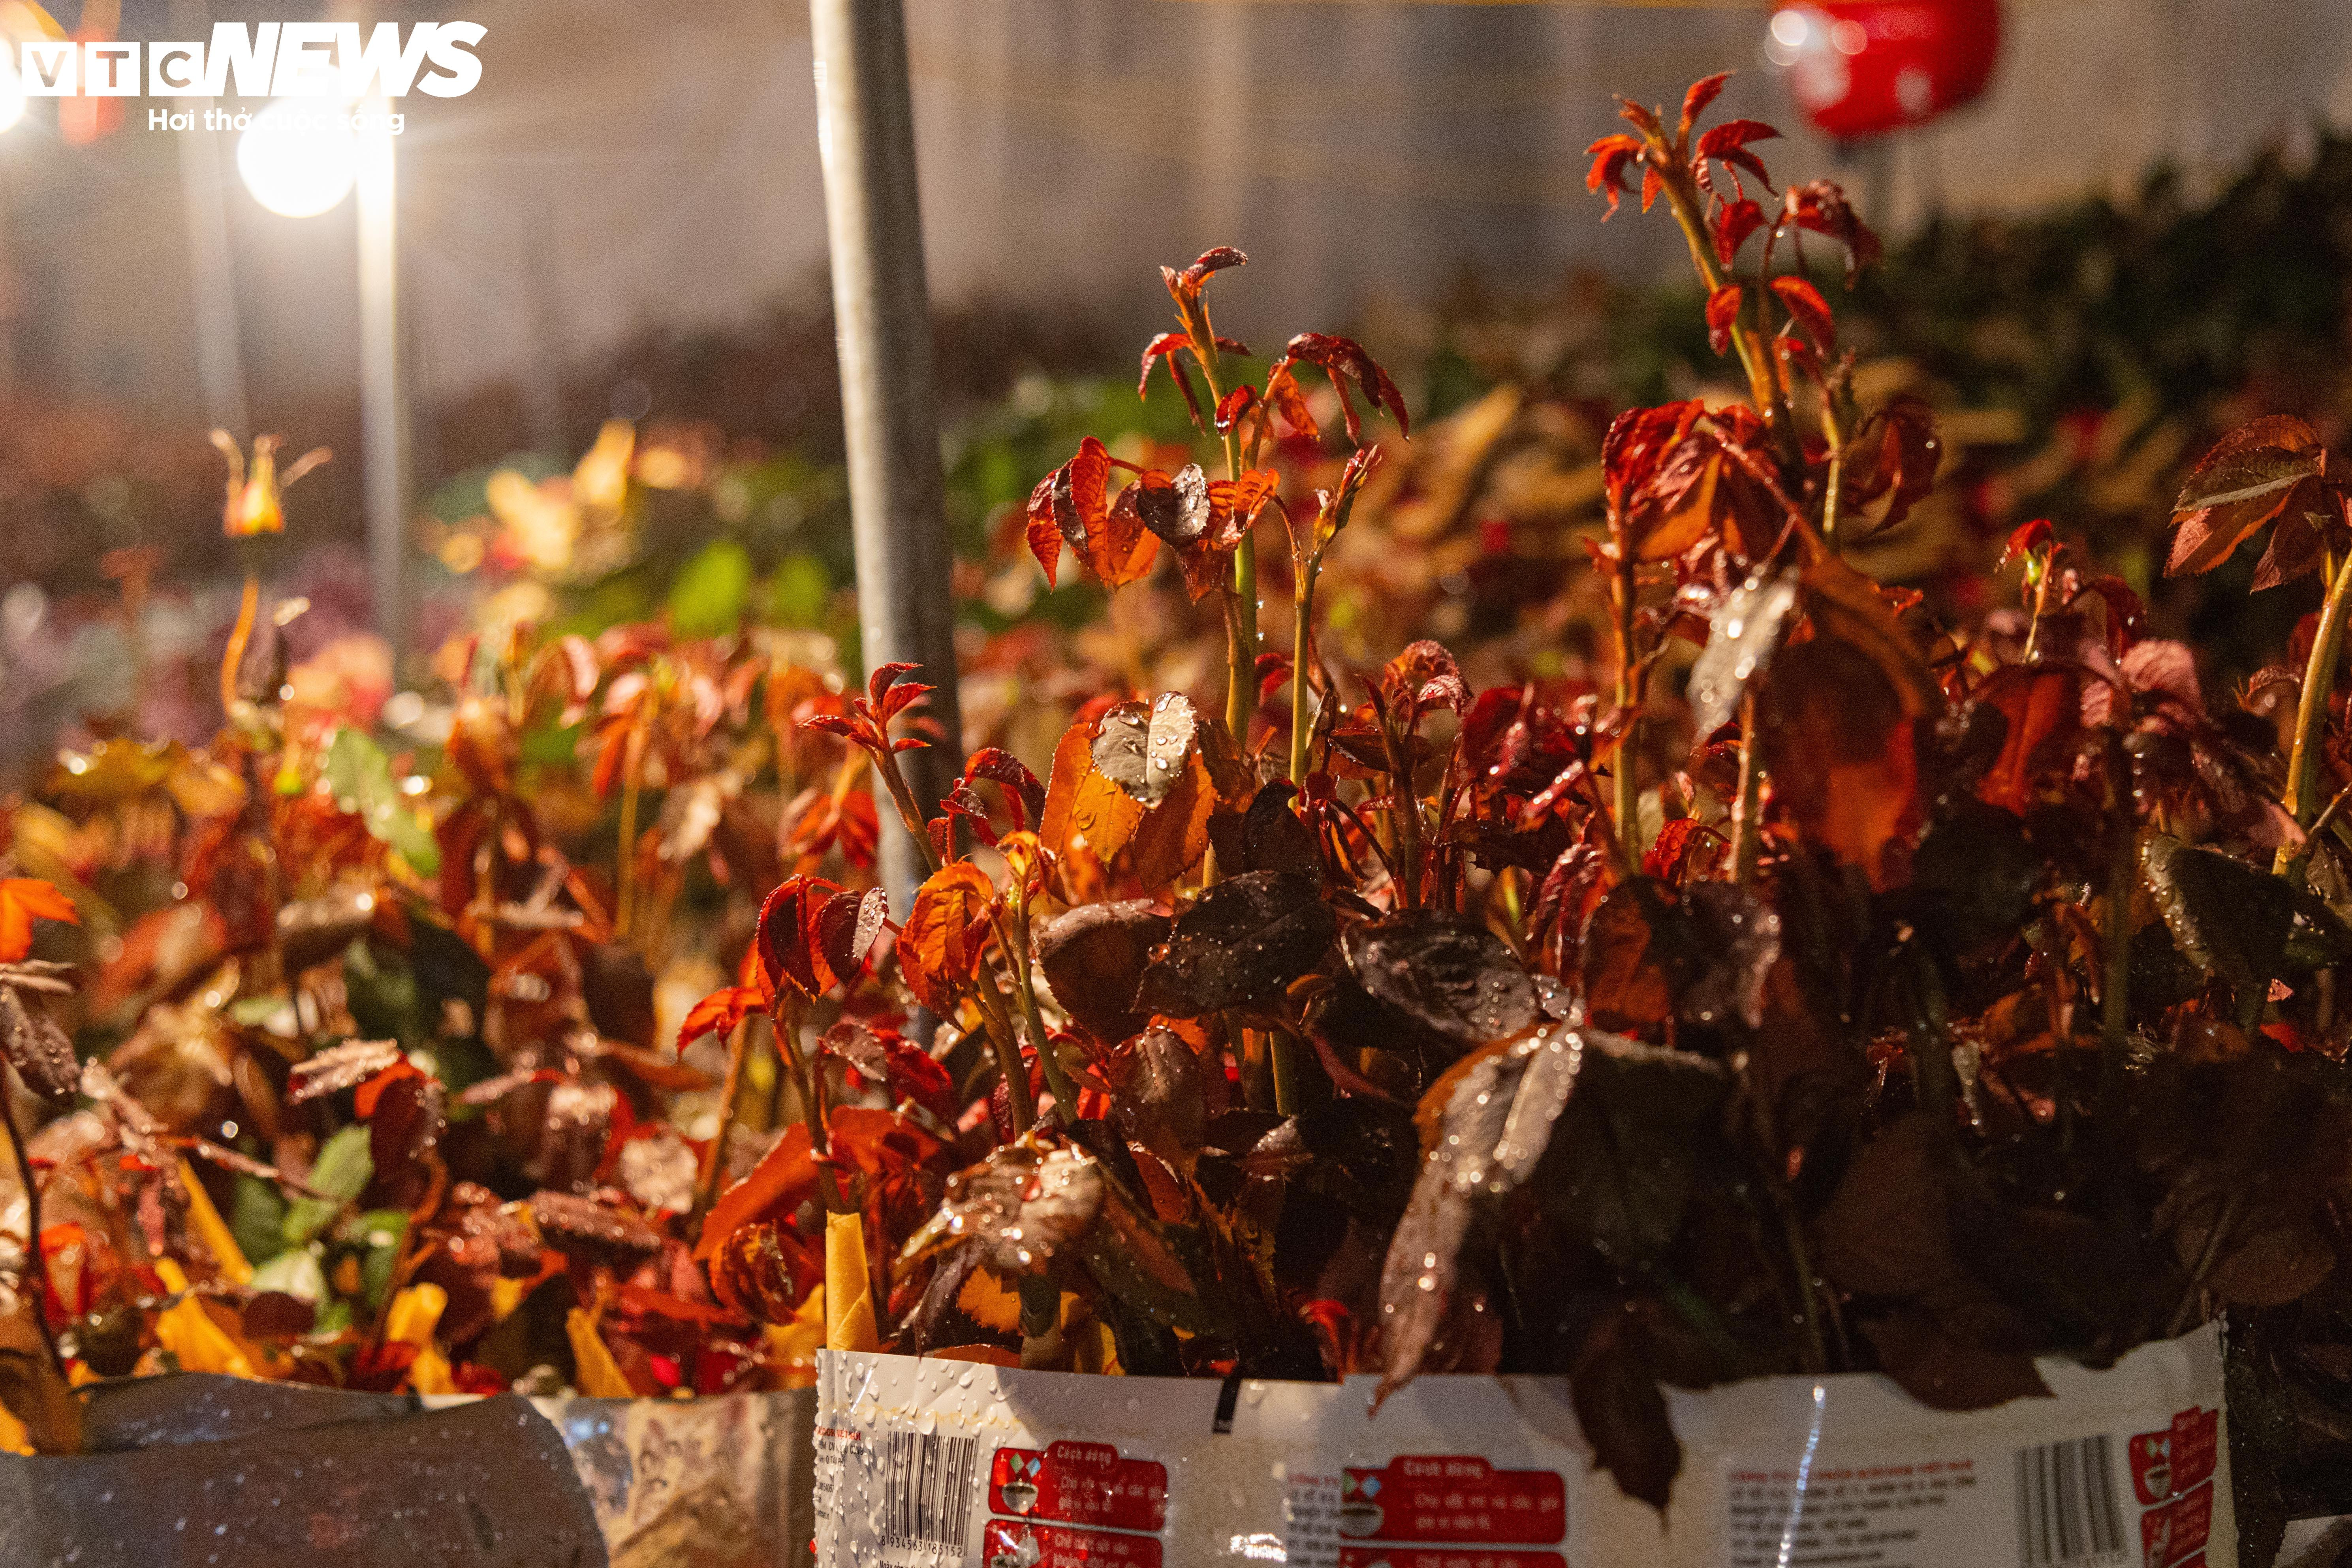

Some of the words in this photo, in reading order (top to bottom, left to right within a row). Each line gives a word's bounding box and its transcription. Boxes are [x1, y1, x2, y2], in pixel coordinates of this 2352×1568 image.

[881, 1535, 886, 1546] 8
[889, 1536, 923, 1551] 934563
[928, 1542, 963, 1558] 185152
